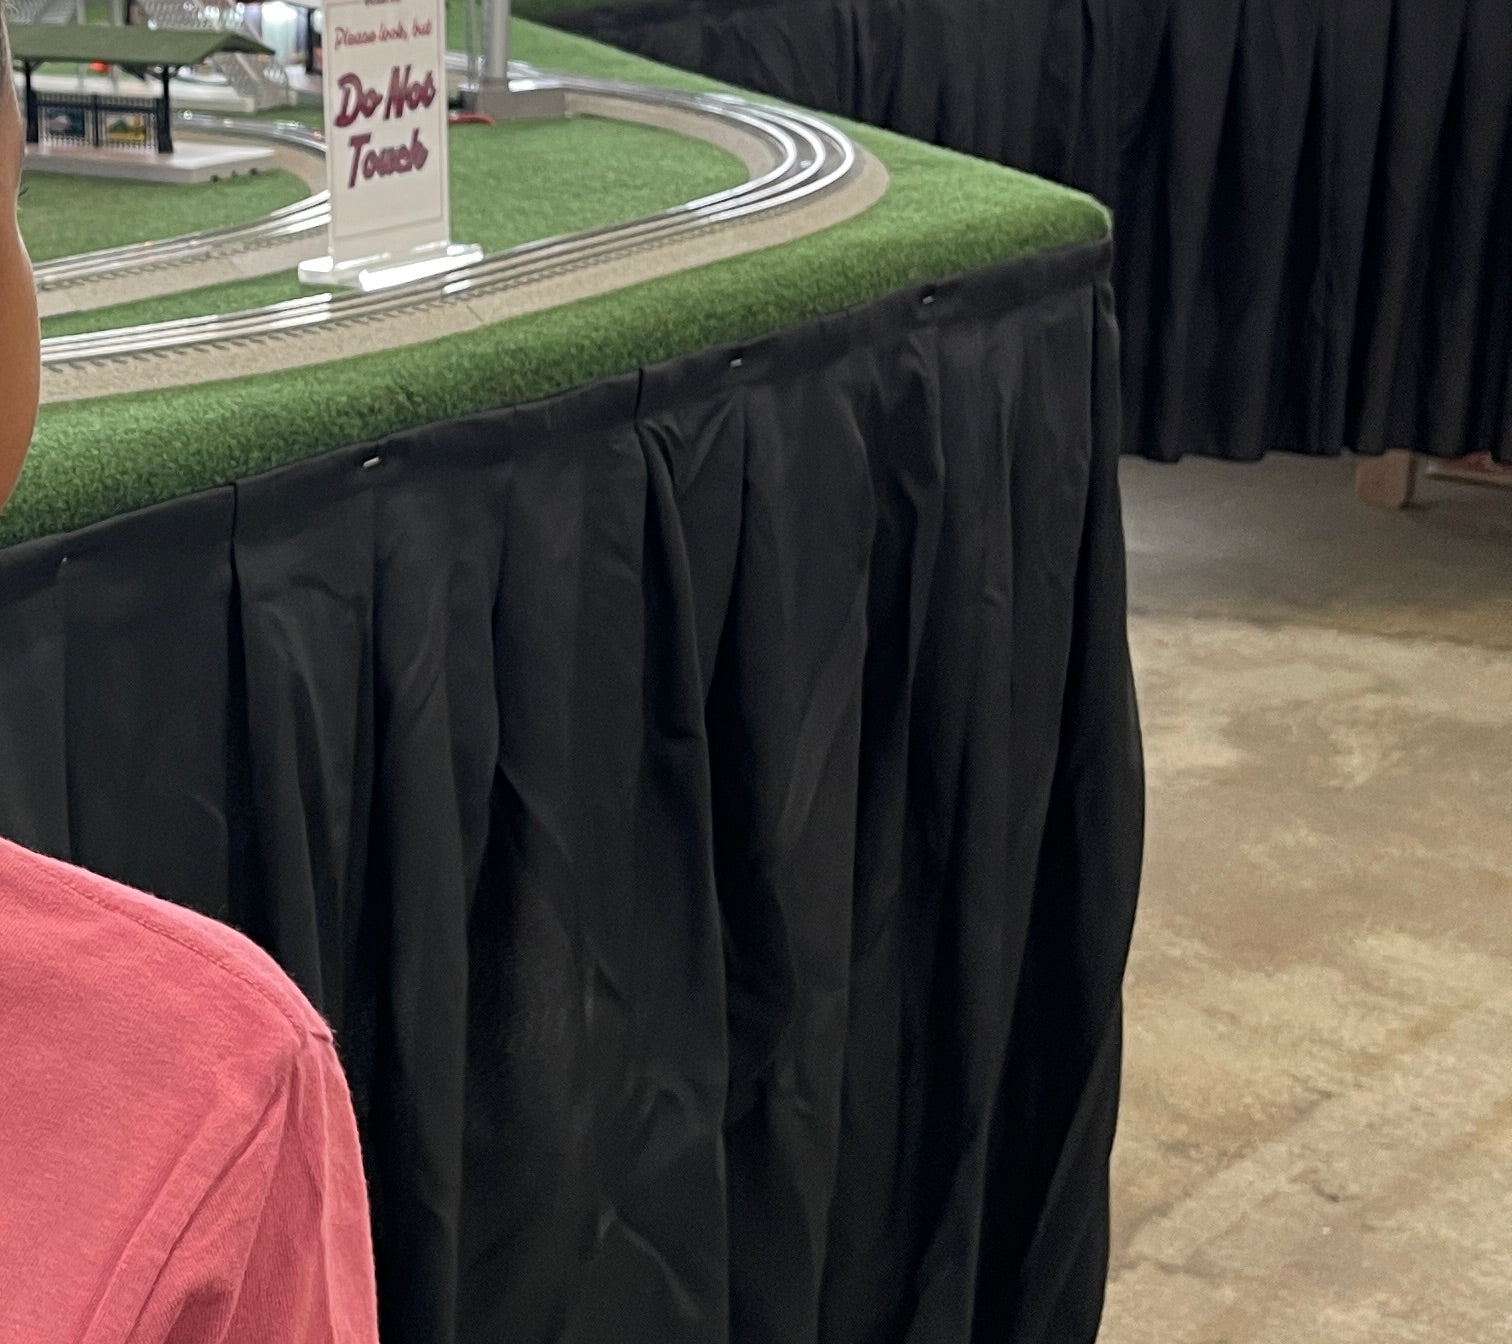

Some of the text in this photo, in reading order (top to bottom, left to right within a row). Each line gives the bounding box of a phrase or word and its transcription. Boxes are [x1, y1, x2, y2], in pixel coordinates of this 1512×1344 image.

[334, 64, 436, 127] Do Not
[348, 128, 429, 188] Touch
